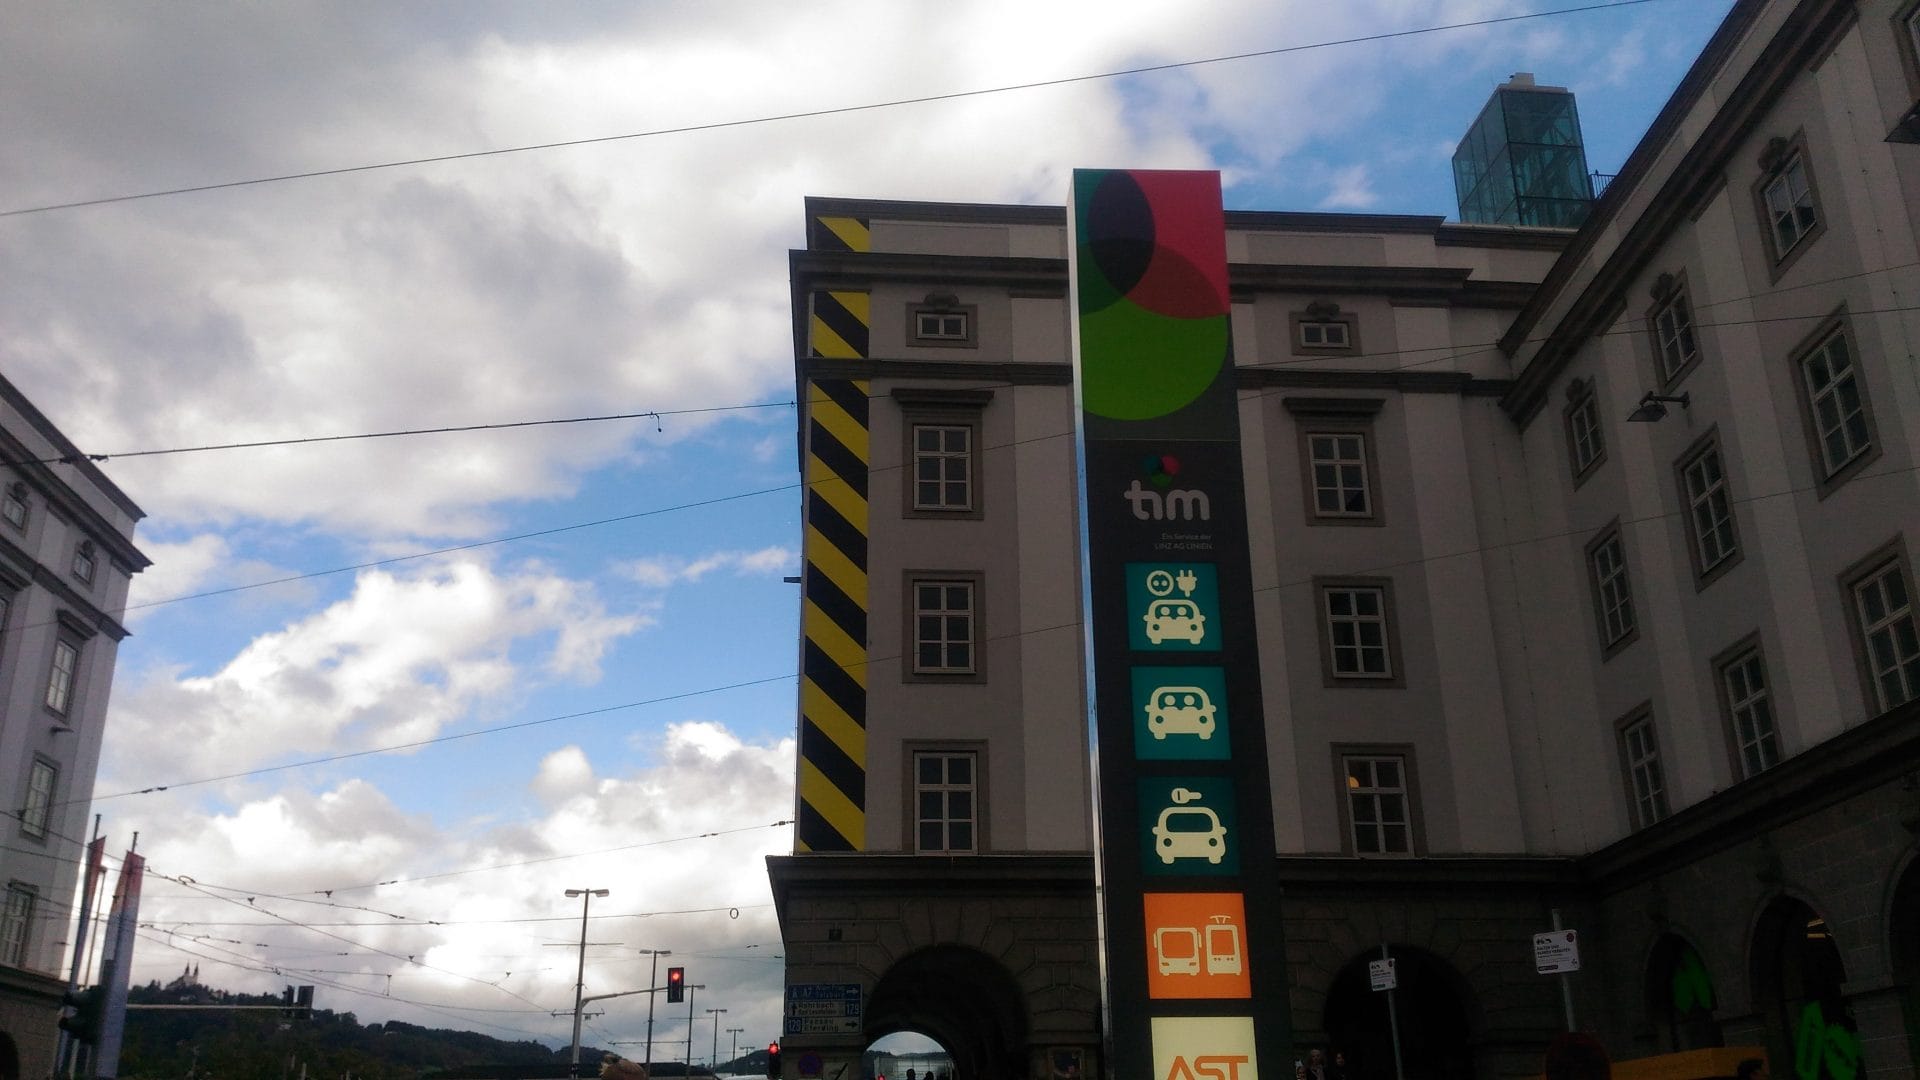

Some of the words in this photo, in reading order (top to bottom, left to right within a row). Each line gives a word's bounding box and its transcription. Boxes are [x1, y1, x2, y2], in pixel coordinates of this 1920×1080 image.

[1123, 479, 1211, 521] tim
[1154, 542, 1172, 550] LINZ
[1173, 542, 1184, 550] AG
[1186, 542, 1213, 550] LINIEN
[1166, 1055, 1249, 1080] AST
